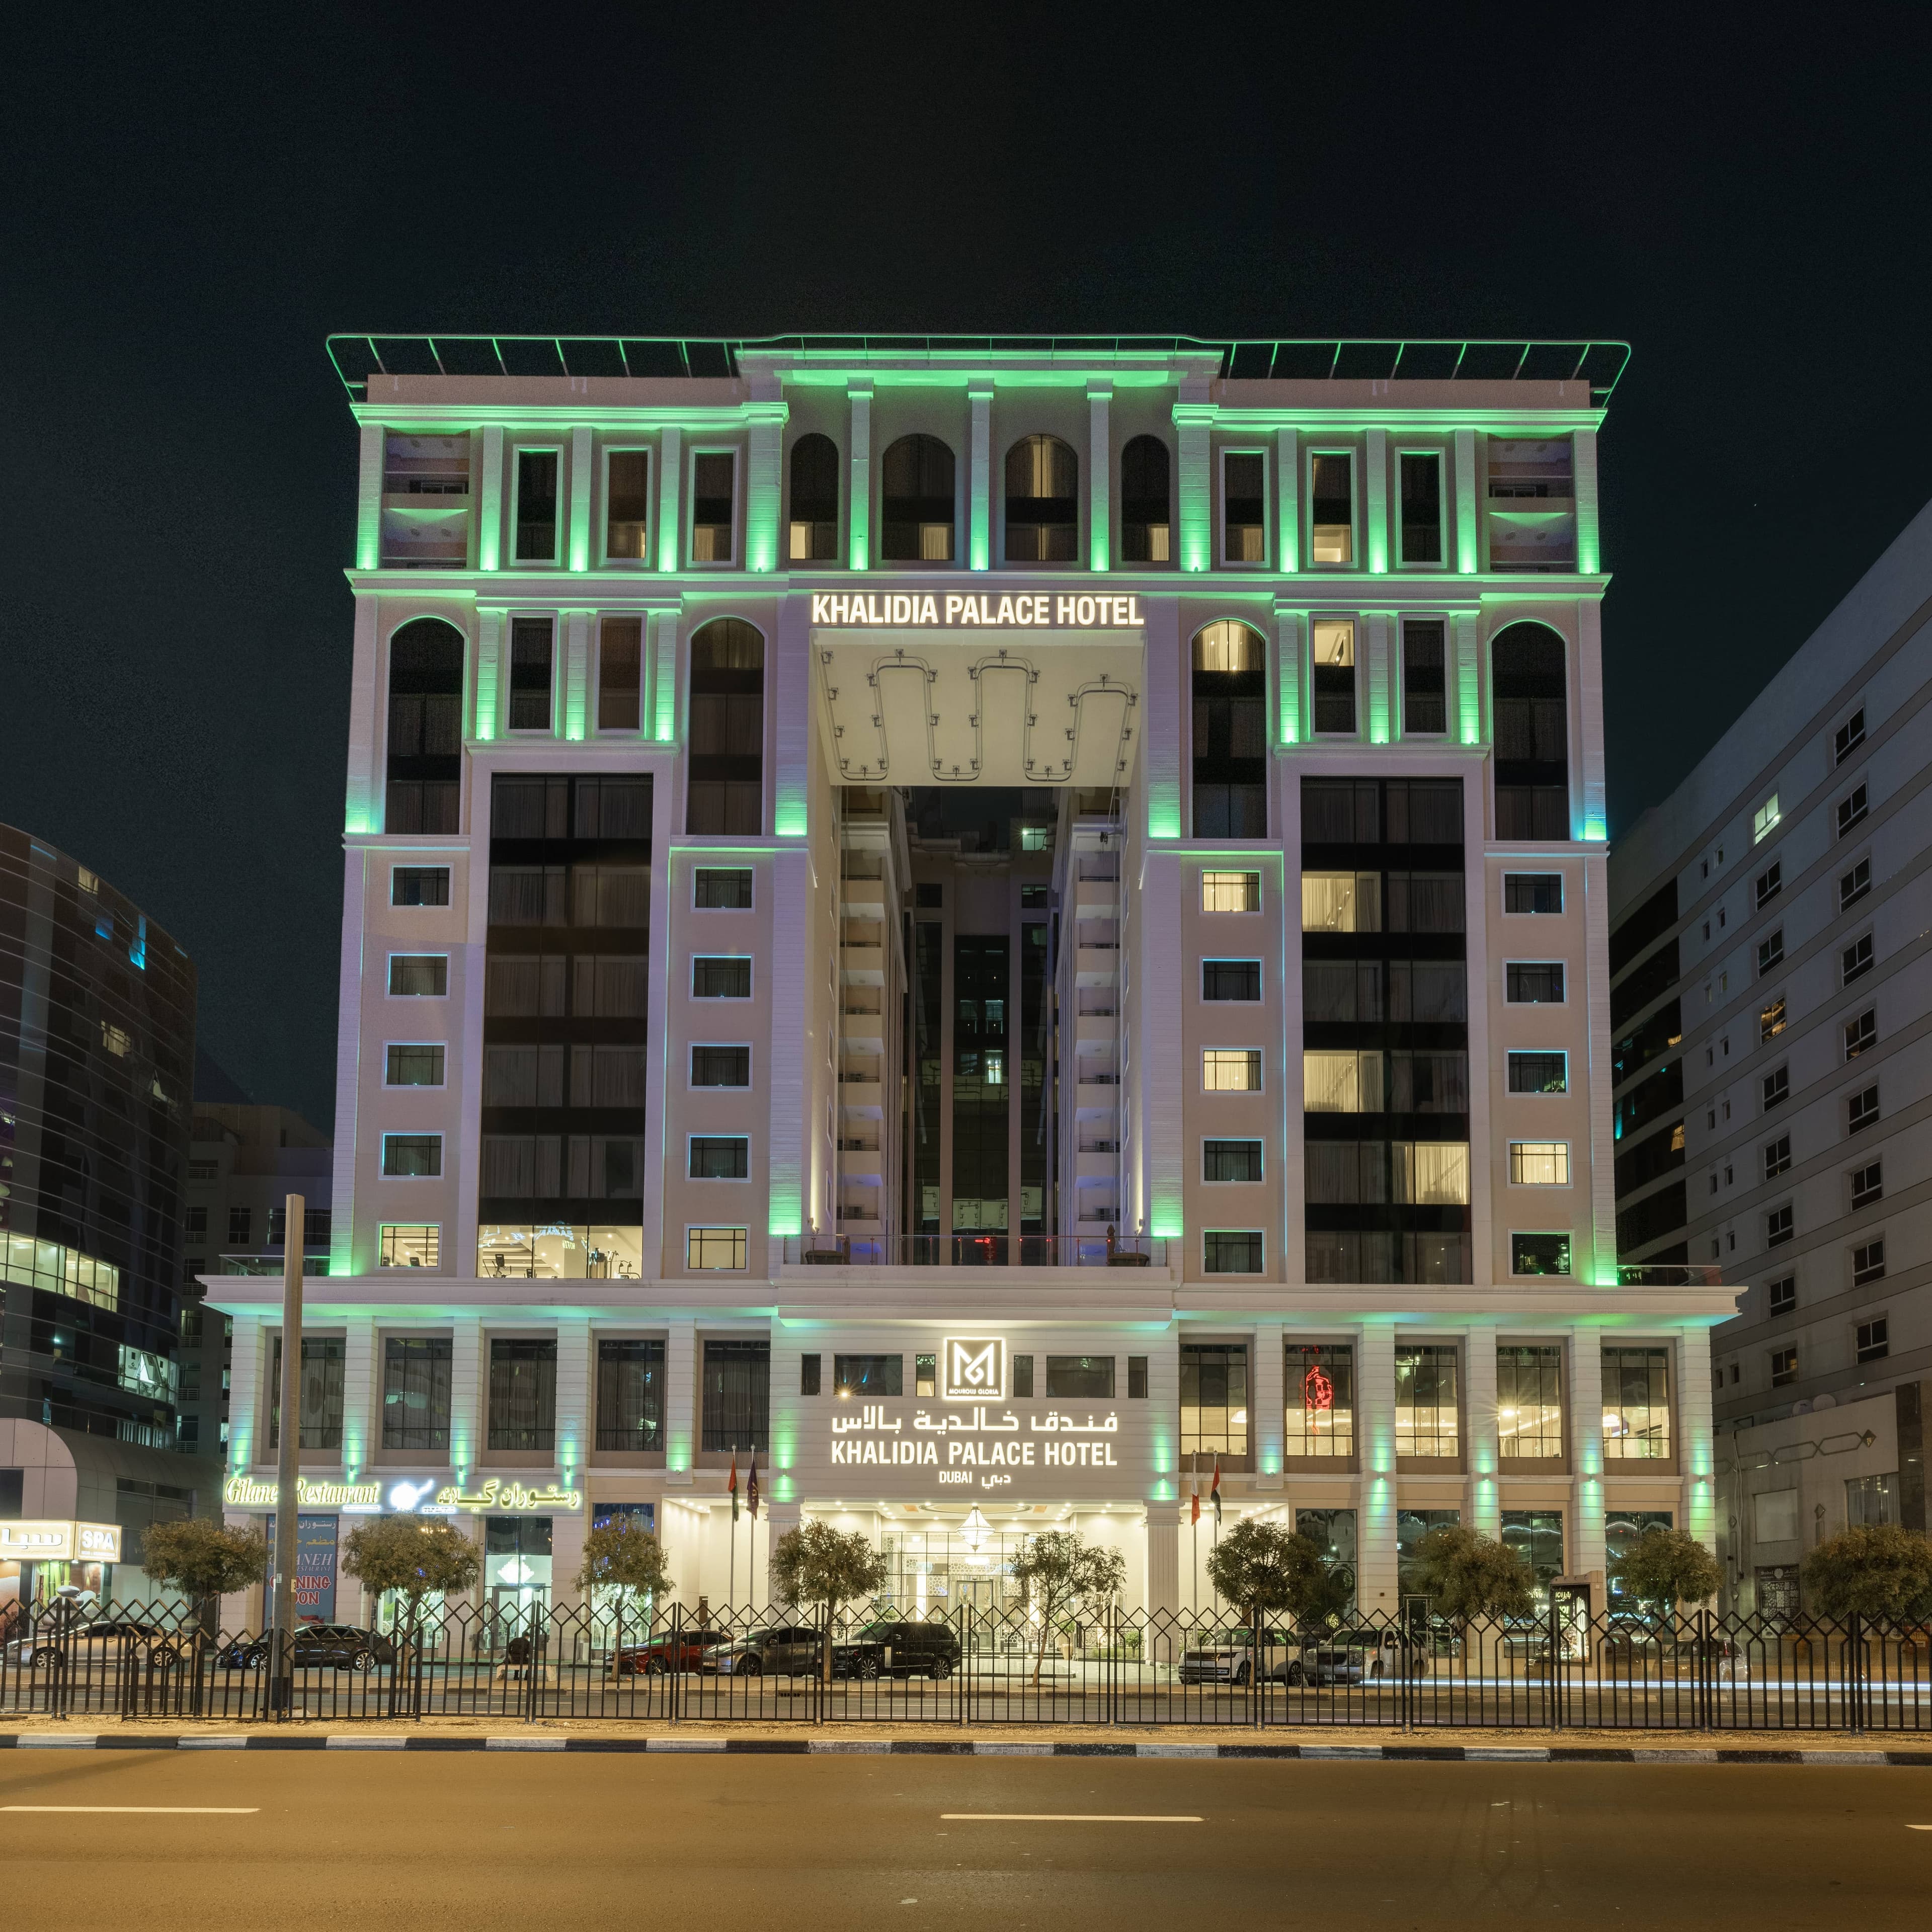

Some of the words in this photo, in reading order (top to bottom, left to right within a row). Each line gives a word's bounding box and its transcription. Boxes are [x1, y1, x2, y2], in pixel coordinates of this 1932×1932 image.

[812, 595, 938, 623] KHALIDIA
[946, 596, 1050, 624] PALACE
[1058, 597, 1144, 625] HOTEL
[832, 1405, 902, 1434] بالاس
[913, 1407, 1019, 1435] خالدية
[1030, 1411, 1118, 1432] فندق
[832, 1440, 938, 1465] KHALIDIA
[949, 1441, 1035, 1465] PALACE
[1044, 1442, 1118, 1466] HOTEL
[939, 1471, 973, 1484] DUBAI
[982, 1474, 1011, 1489] دبي
[82, 1530, 115, 1550] SPA
